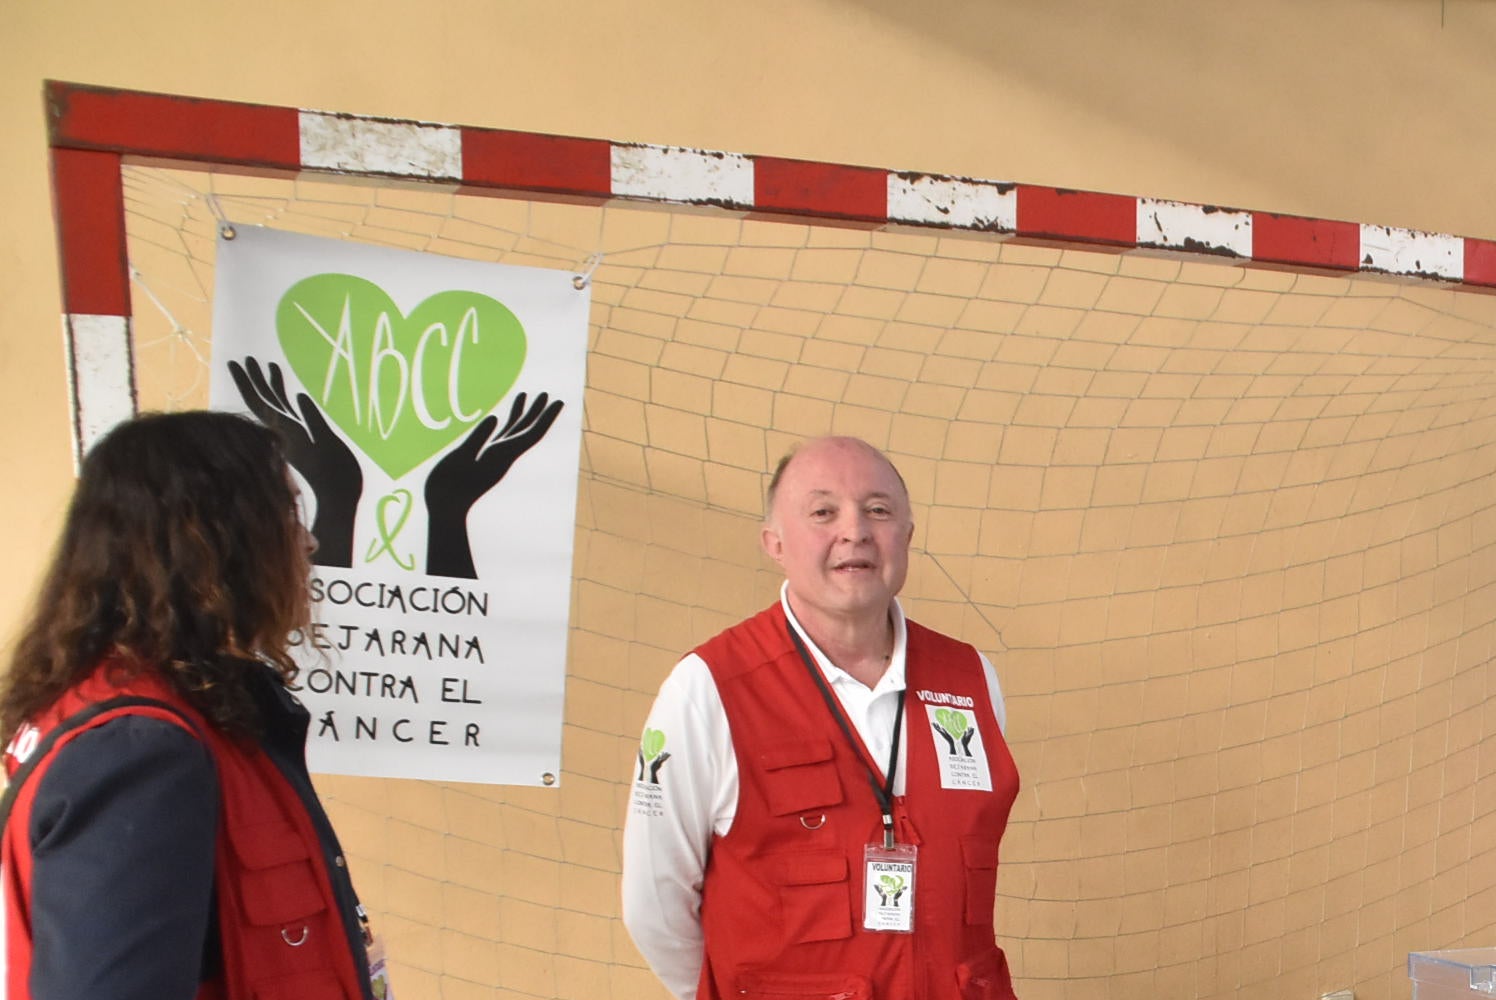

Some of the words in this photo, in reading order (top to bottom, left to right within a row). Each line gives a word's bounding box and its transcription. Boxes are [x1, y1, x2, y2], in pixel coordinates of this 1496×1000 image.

[293, 291, 483, 440] ABCC
[310, 577, 488, 617] SOCIACIÓN
[441, 677, 482, 704] EL
[916, 690, 974, 708] VOLUNTARIO
[318, 710, 480, 747] ÁNCER
